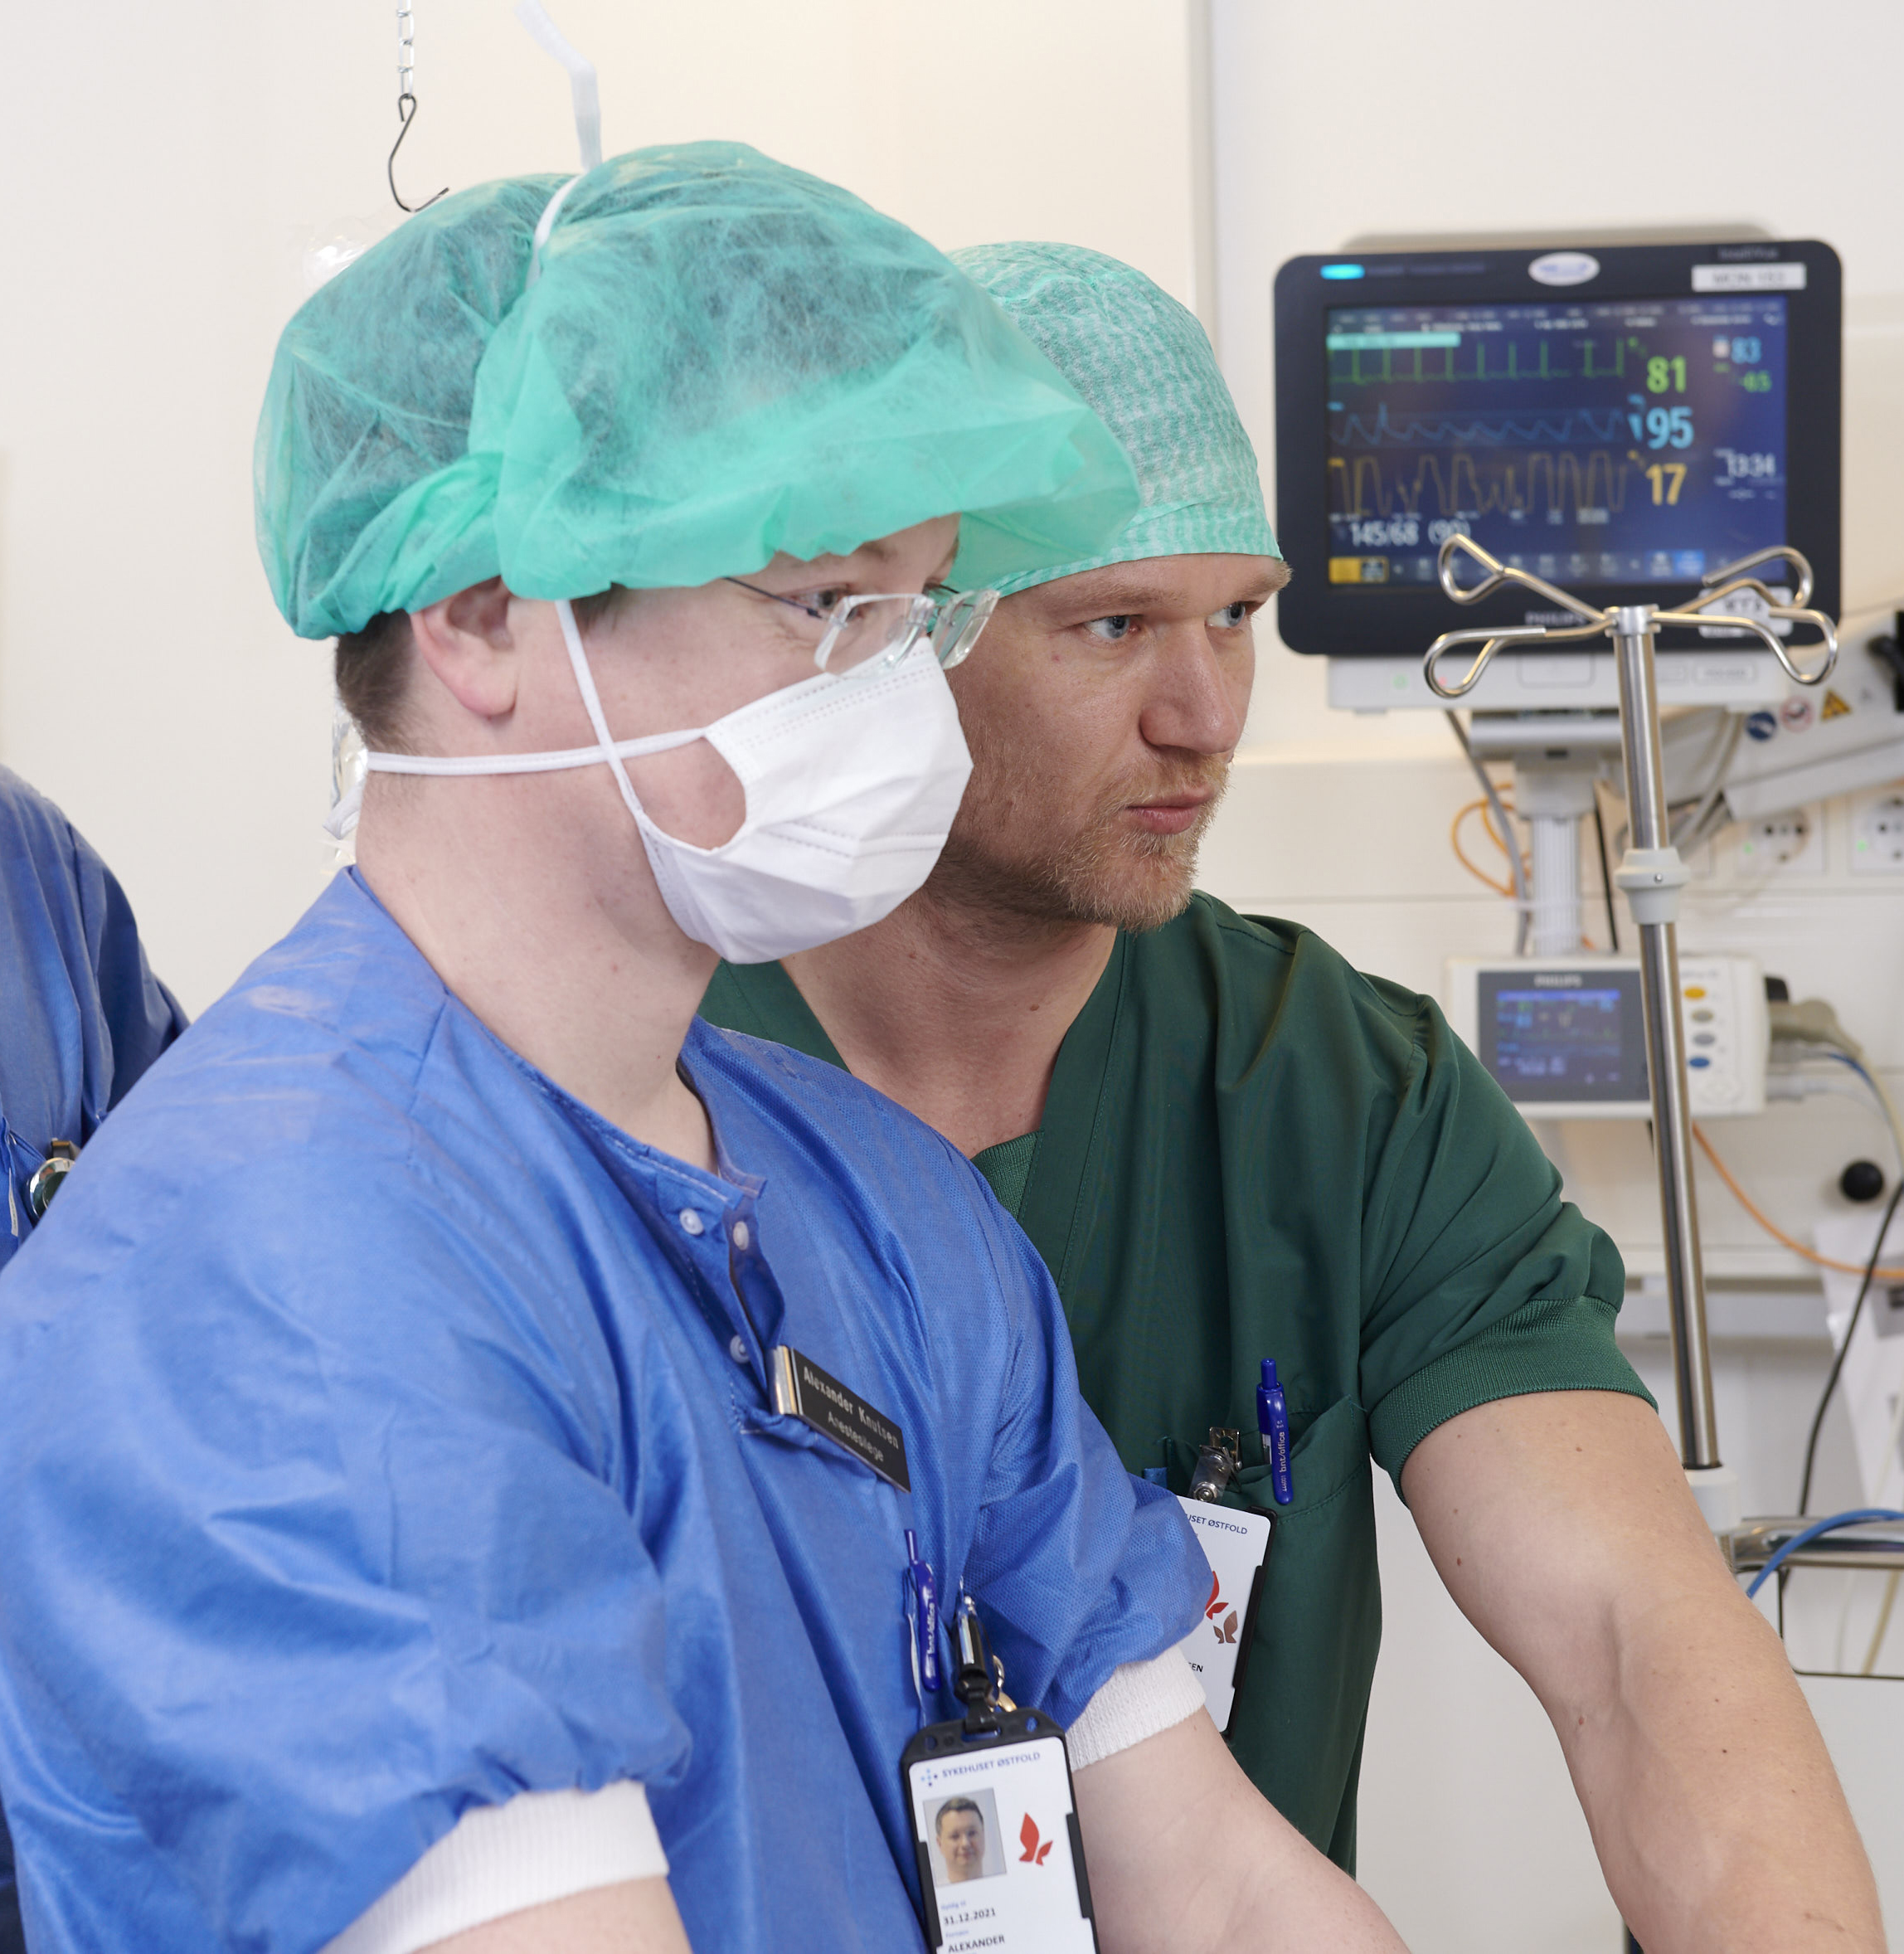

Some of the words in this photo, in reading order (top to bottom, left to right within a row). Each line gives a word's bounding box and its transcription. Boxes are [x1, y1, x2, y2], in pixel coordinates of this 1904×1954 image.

[1646, 355, 1687, 394] 81
[1645, 406, 1694, 450] 95
[1645, 463, 1687, 506] 17
[804, 1366, 853, 1415] Alexander
[858, 1406, 899, 1450] Knutsen
[1277, 1431, 1287, 1473] bnt/office
[1207, 1519, 1247, 1534] ØSTFOLD
[942, 1761, 994, 1778] SYKEHUSET
[997, 1752, 1041, 1767] ØSTFOLD
[944, 1907, 996, 1925] 31.12.2021
[948, 1935, 1005, 1953] ALEXANDER
